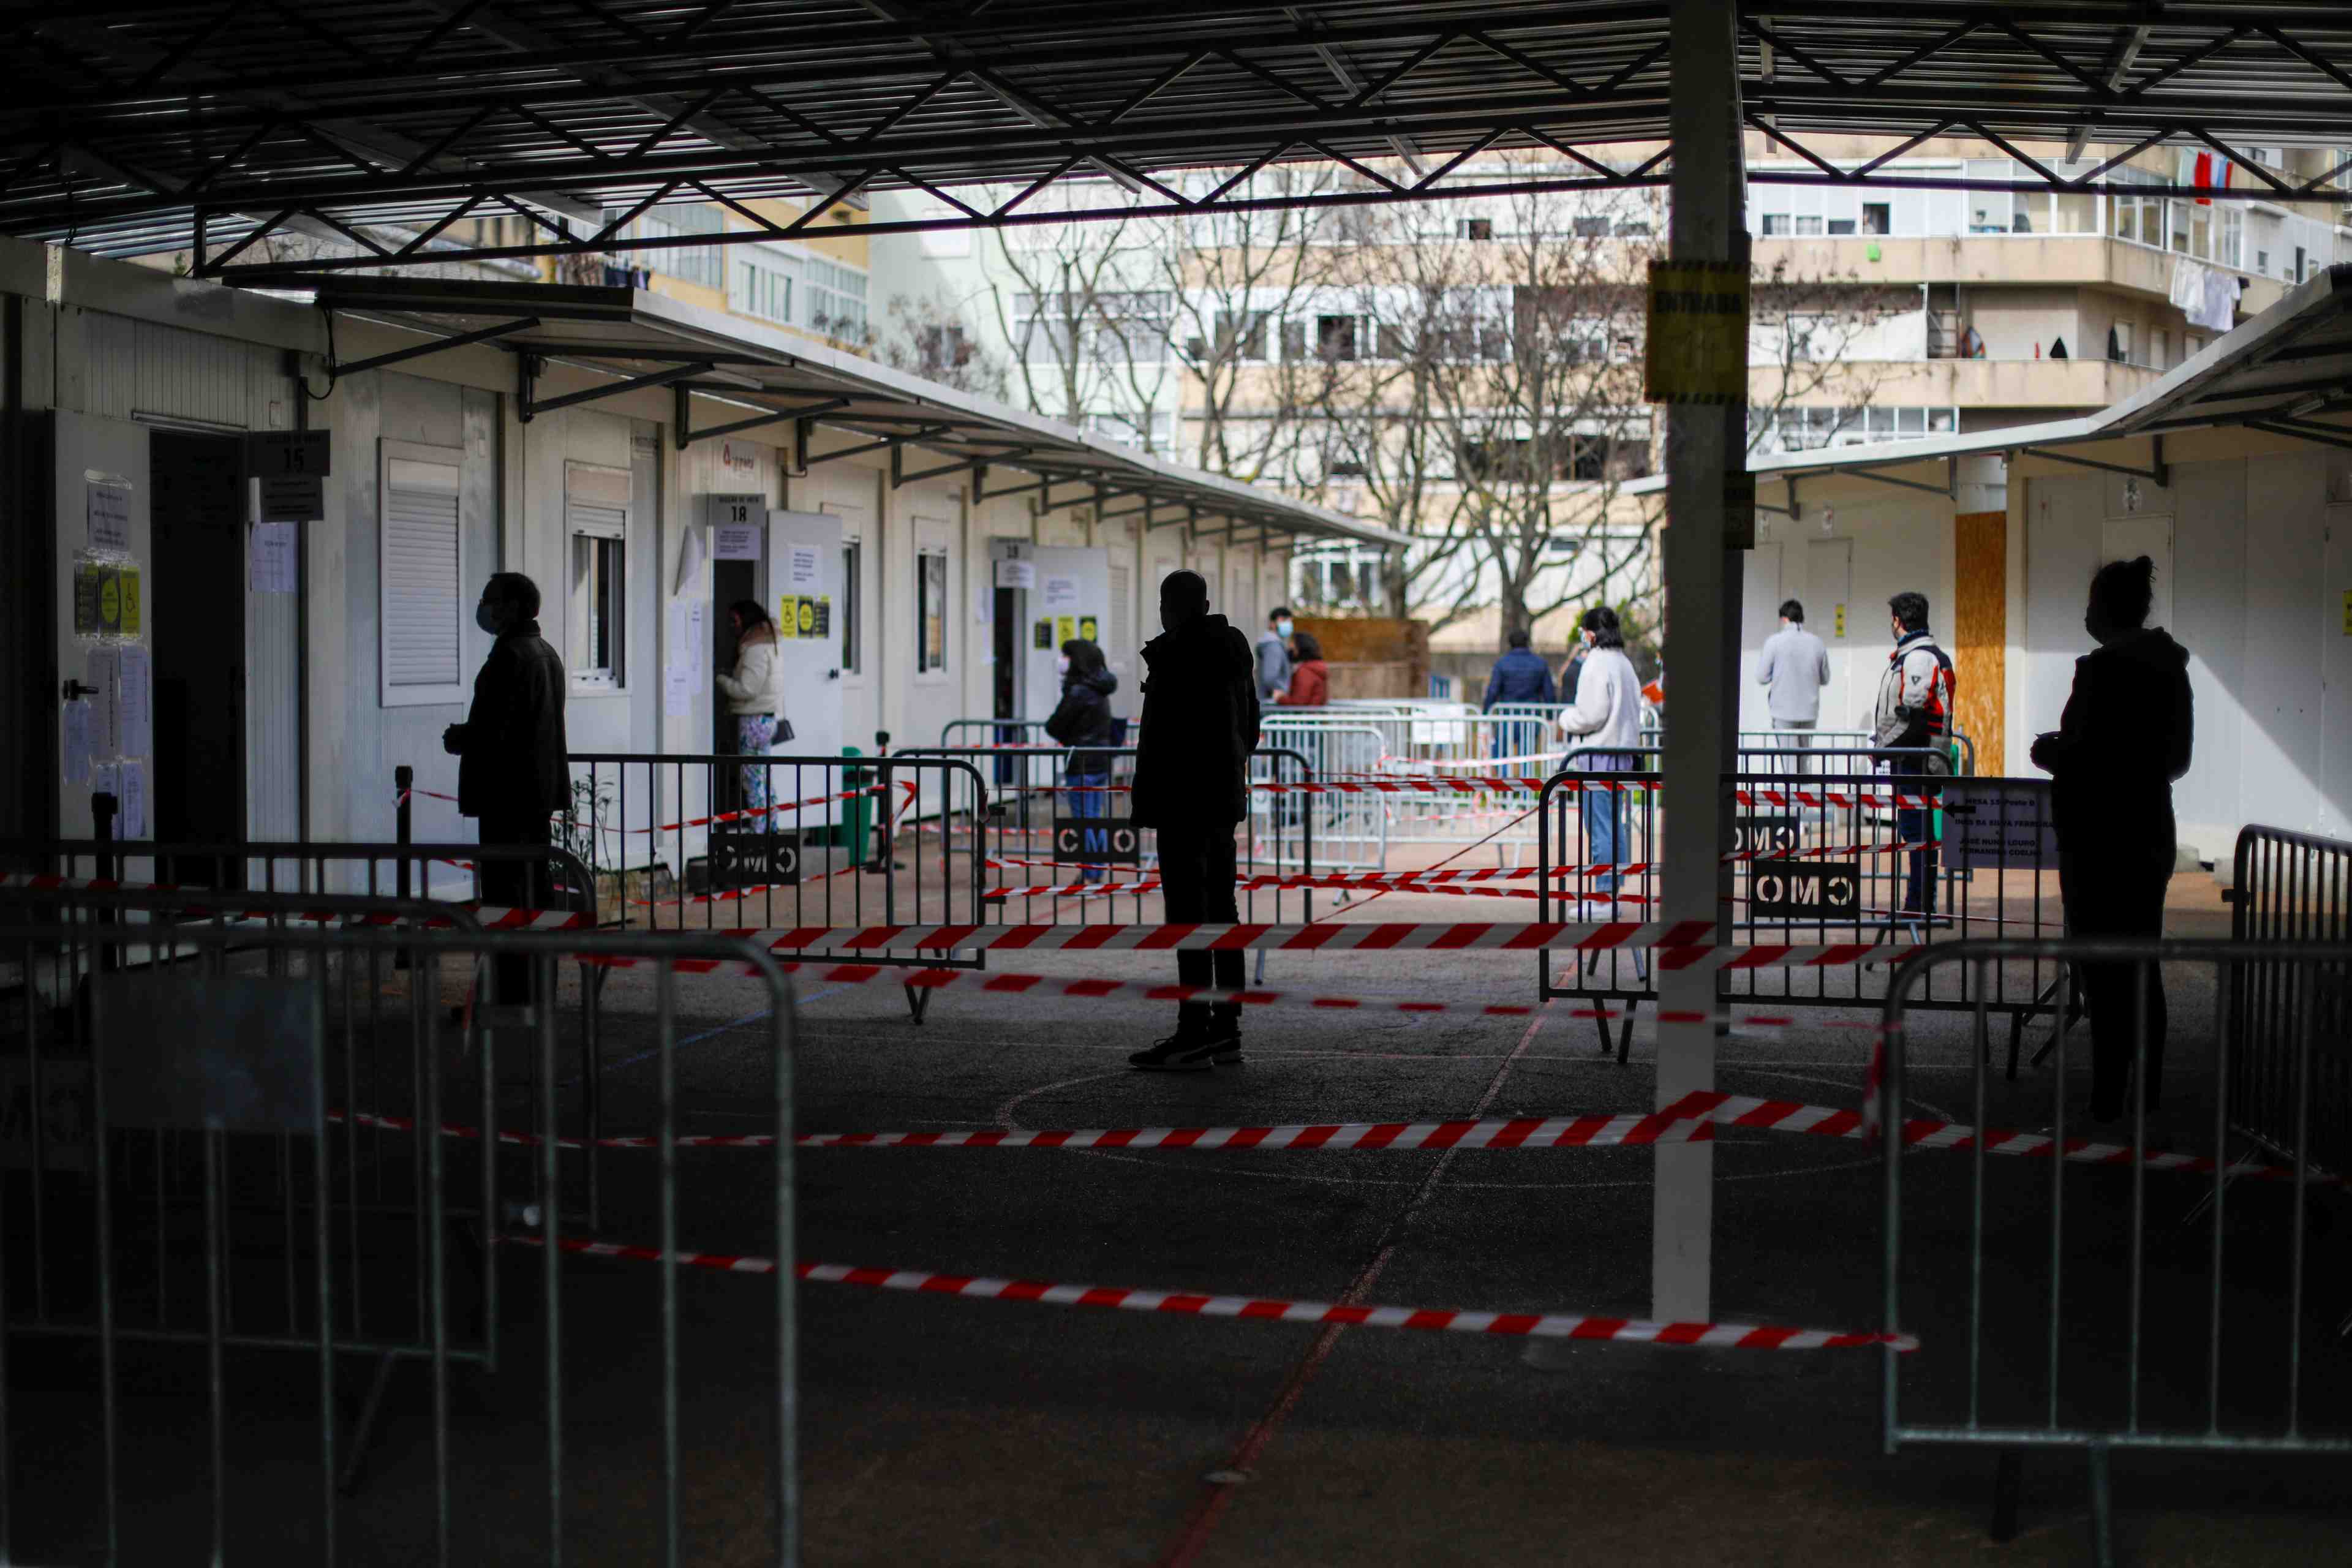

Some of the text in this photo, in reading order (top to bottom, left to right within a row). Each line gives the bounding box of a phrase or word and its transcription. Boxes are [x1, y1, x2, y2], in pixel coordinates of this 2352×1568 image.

[284, 448, 304, 473] 15
[731, 506, 747, 521] 18
[1058, 827, 1136, 853] CMO
